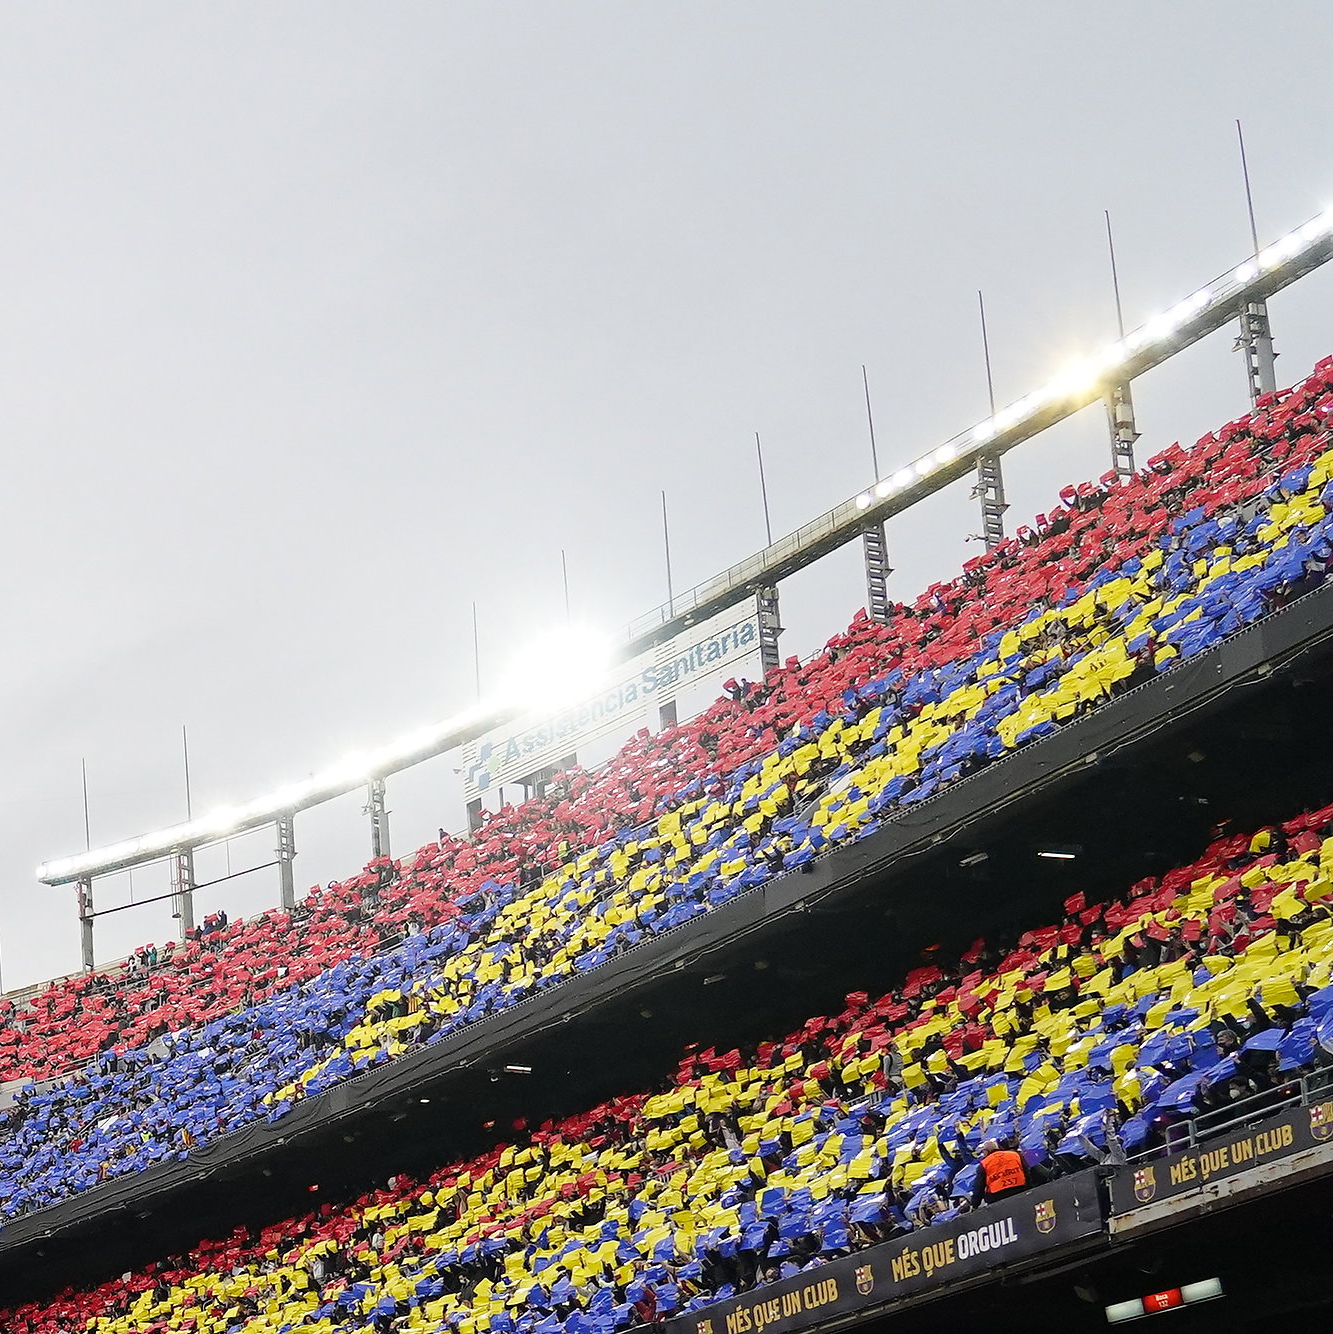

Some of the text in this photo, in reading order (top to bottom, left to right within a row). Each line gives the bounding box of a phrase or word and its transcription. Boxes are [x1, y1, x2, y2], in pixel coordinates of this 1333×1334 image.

[1170, 1125, 1293, 1186] MÉS QUE UN CLUB
[891, 1217, 1018, 1283] MÉS QUE ORGULL
[753, 1298, 781, 1332] QUE
[782, 1291, 801, 1318] UN
[804, 1278, 838, 1310] CLUB
